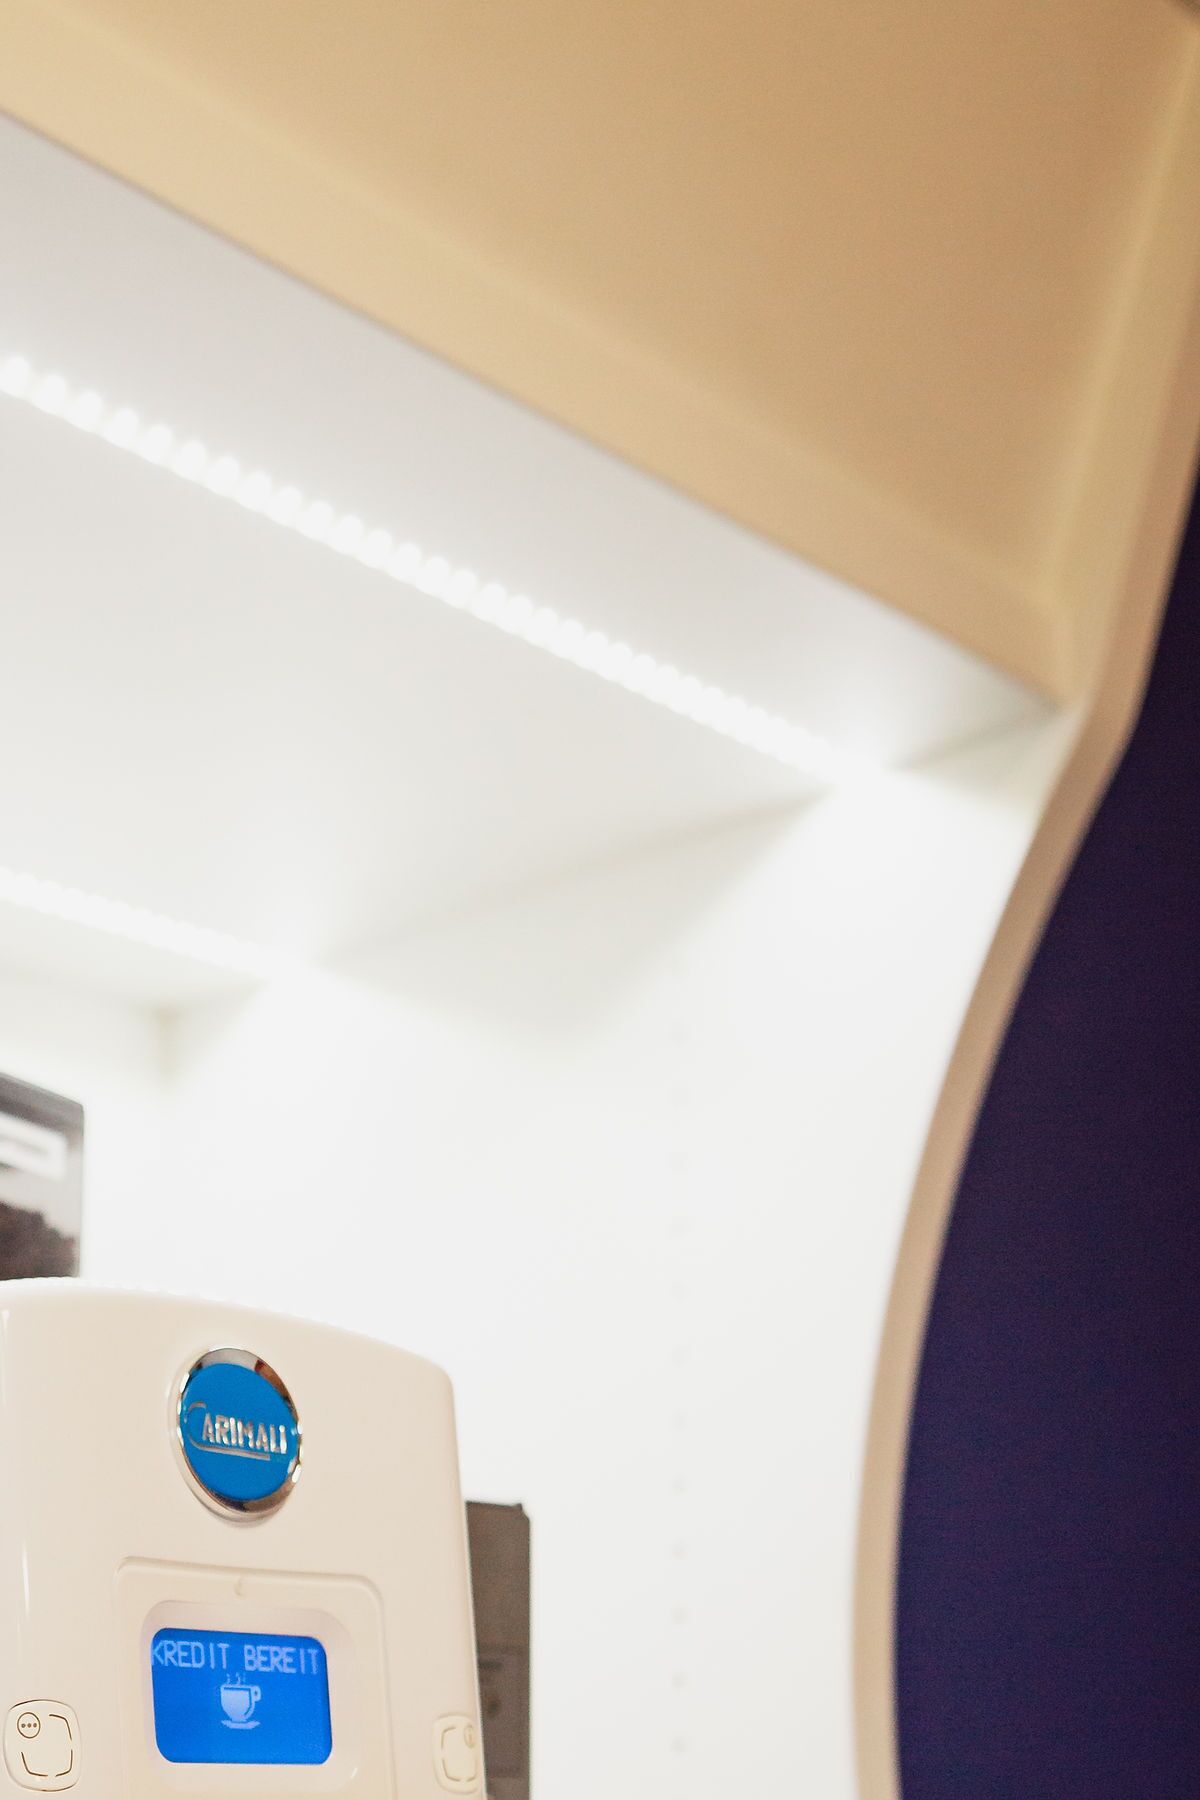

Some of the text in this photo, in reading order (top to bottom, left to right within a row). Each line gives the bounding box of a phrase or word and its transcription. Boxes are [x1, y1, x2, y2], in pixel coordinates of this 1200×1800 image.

[184, 1400, 287, 1461] CARIMALI
[151, 1639, 320, 1675] KREDIT BEREIT
